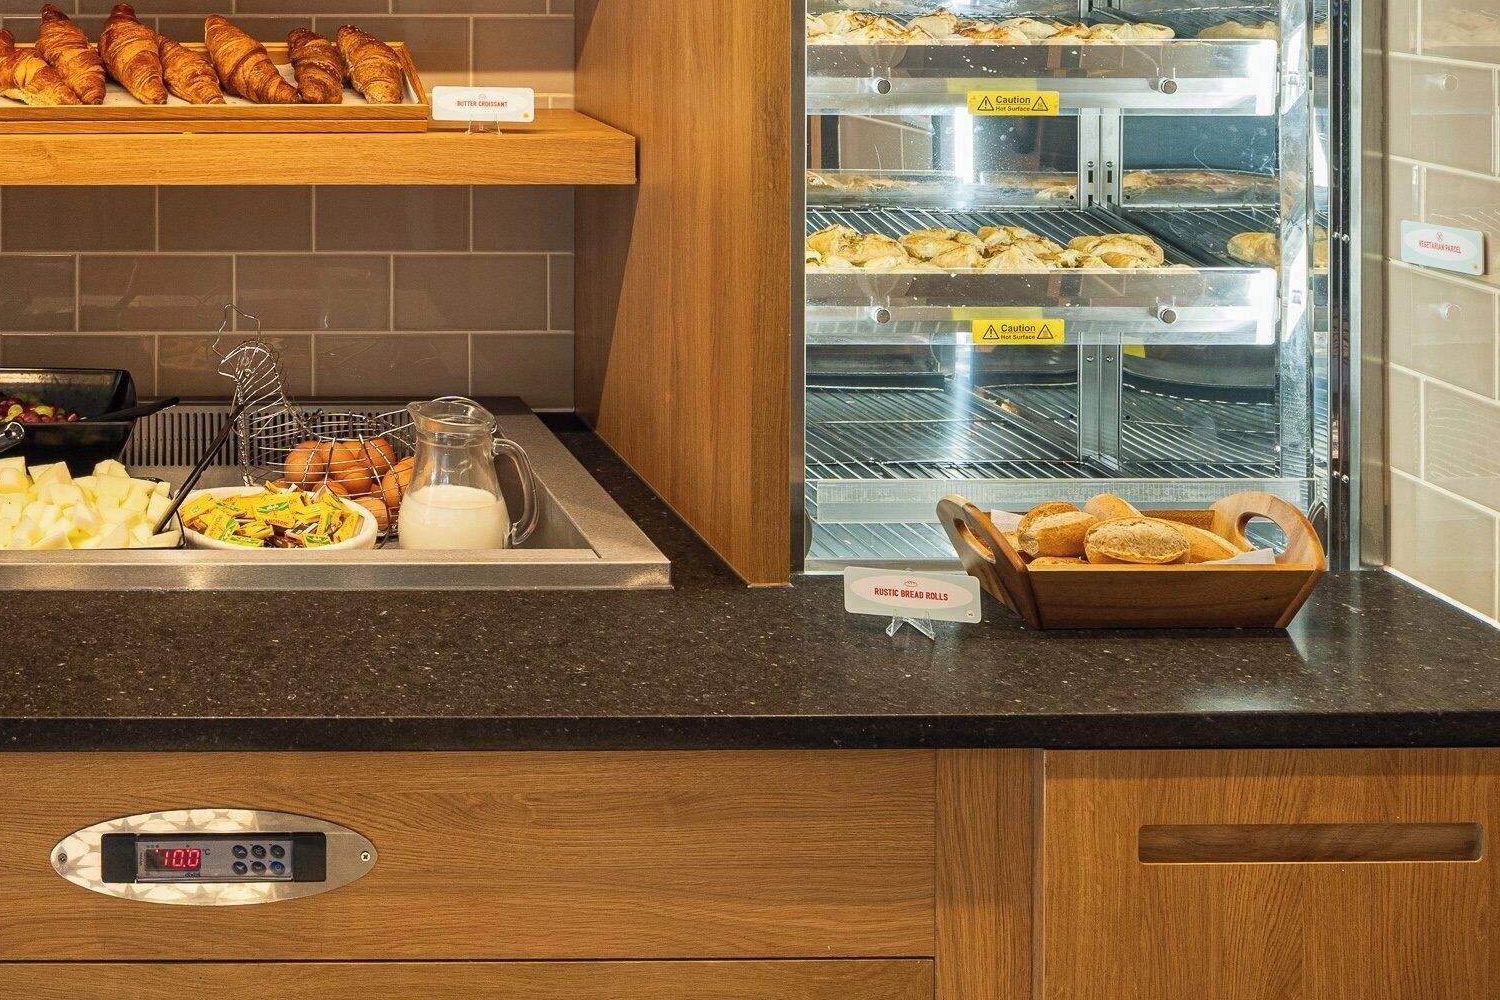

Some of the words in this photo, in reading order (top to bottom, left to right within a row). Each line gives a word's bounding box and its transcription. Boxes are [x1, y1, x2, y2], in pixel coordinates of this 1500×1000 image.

[995, 95, 1031, 104] Caution
[1418, 239, 1445, 251] VEGETARIAN
[1444, 244, 1462, 254] PARCEL
[1001, 324, 1037, 333] Caution
[874, 587, 899, 598] RUSTIC
[900, 590, 924, 600] BREAD
[925, 591, 949, 602] ROLLS
[163, 848, 200, 868] 10.0
